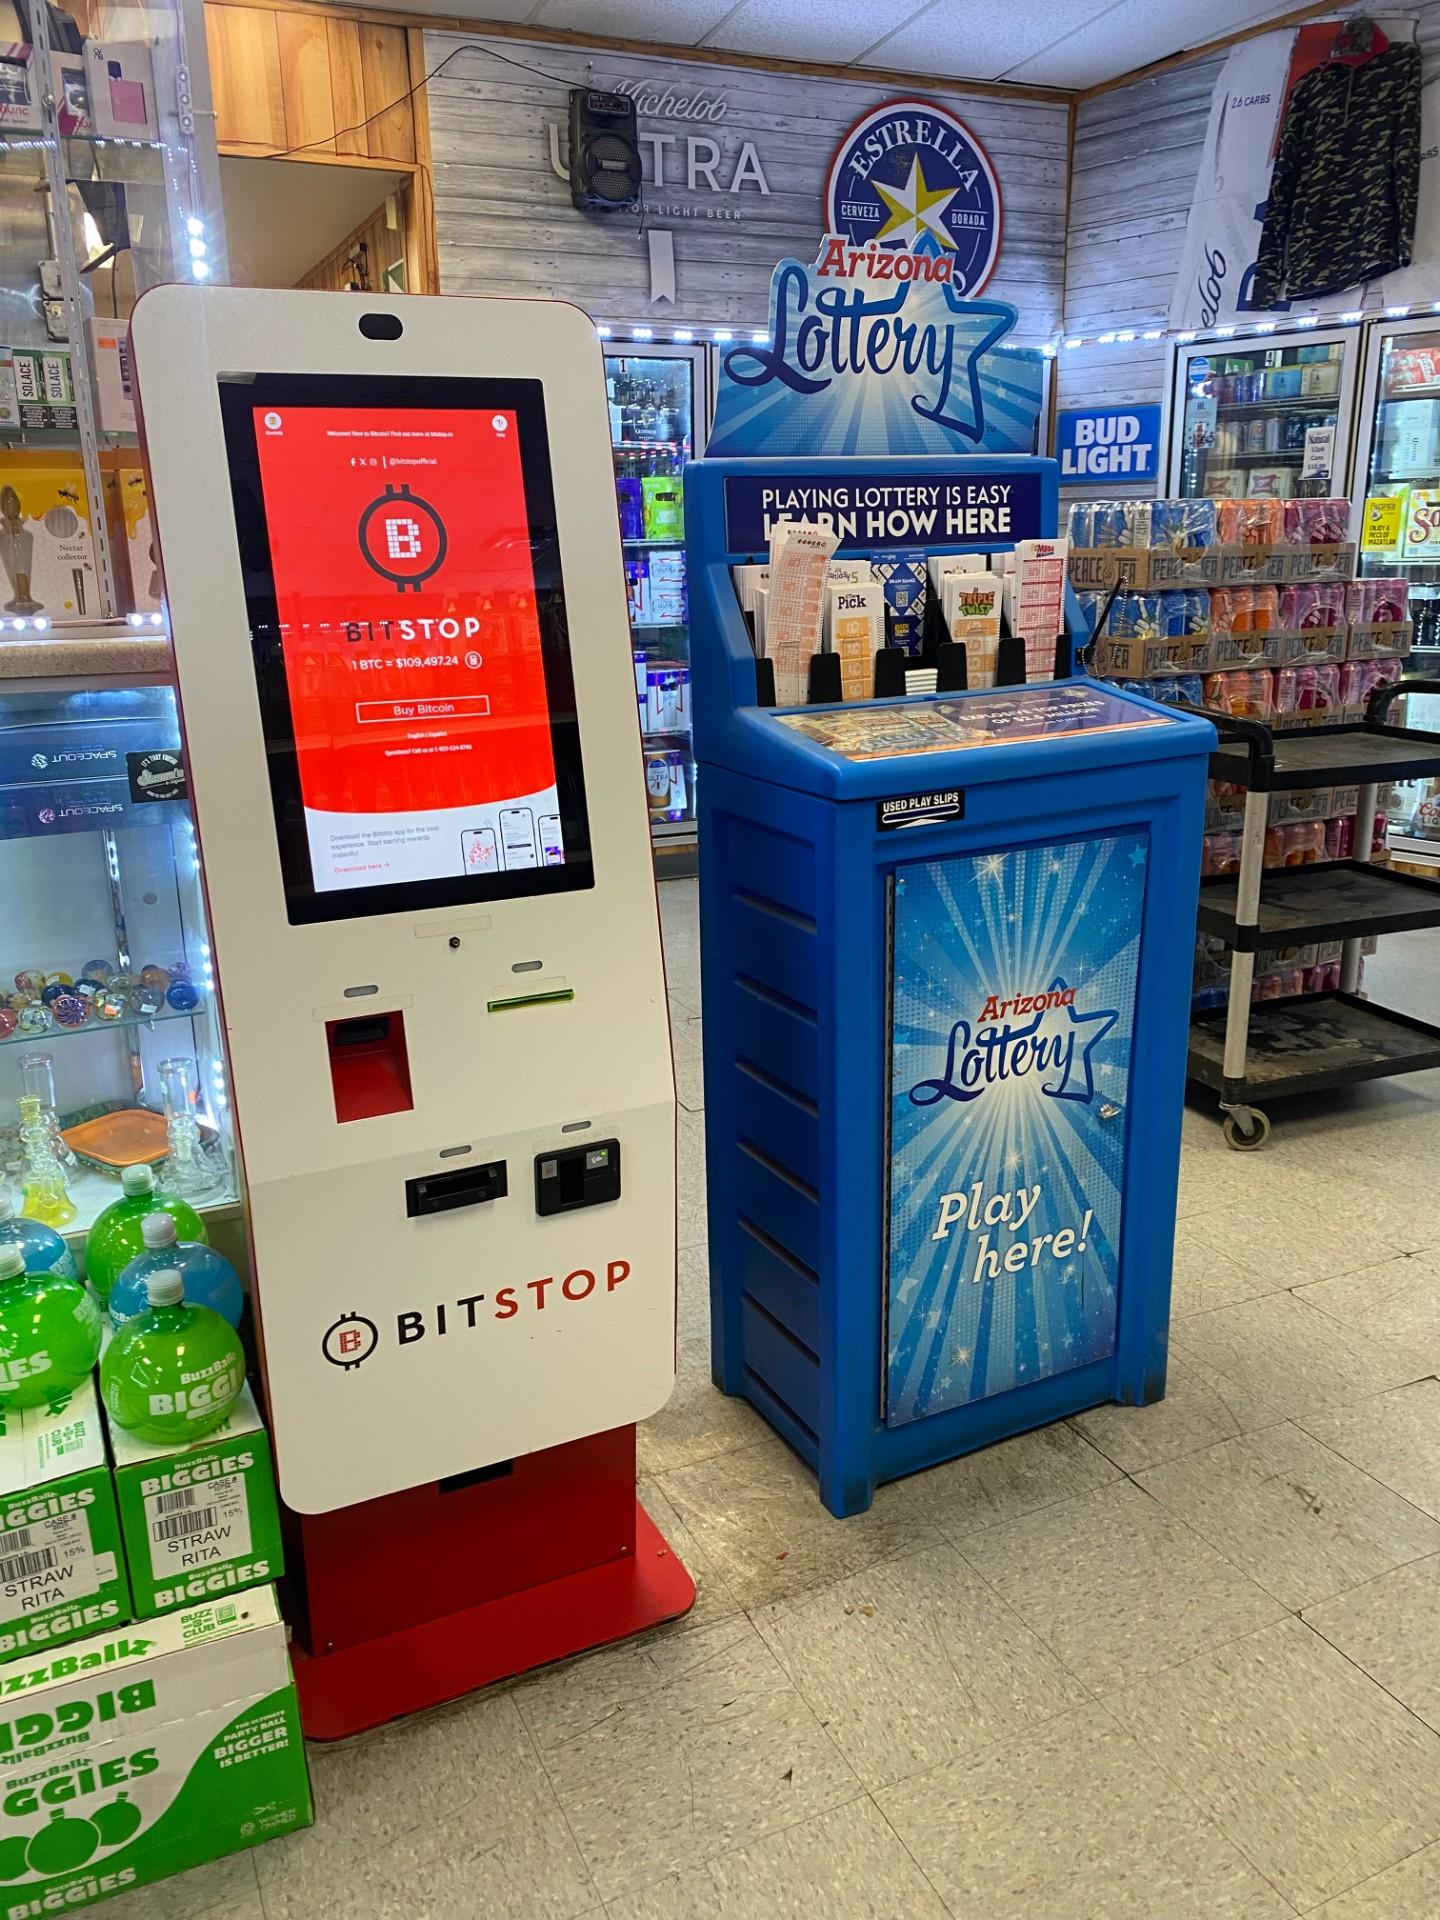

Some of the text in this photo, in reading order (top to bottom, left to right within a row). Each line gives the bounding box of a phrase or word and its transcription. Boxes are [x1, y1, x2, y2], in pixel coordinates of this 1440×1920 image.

[1244, 93, 1271, 106] CARBS
[550, 123, 771, 194] UTRA
[848, 119, 979, 192] ESTRELLA
[658, 206, 698, 217] LIGHT
[707, 209, 741, 220] BEER
[841, 204, 880, 219] CERVEZA
[951, 212, 986, 227] DORADA
[817, 239, 953, 283] Arizona
[724, 264, 980, 440] Lottery
[20, 361, 34, 397] SOLACE
[48, 364, 62, 398] SOLACE
[1075, 416, 1140, 446] BUD
[1062, 444, 1152, 475] LIGHT
[762, 485, 1011, 509] PLAYING LOTTERY IS EASY
[866, 507, 1011, 537] HOW HERE
[57, 553, 88, 561] collector
[838, 593, 867, 610] Pick
[959, 591, 996, 604] TRIPLE
[959, 604, 994, 617] TWIST
[346, 617, 480, 642] BITSTOP
[352, 660, 357, 670] 1
[360, 658, 383, 670] BTC
[395, 655, 459, 669] $109,497.24
[393, 702, 455, 717] Buy Bitcoin
[51, 750, 117, 763] SPACEOUT
[883, 791, 959, 812] USED PLAY SLIPS
[977, 987, 1077, 1023] Arizona
[909, 1012, 1094, 1106] Lottery
[931, 1181, 1041, 1240] Play
[973, 1210, 1093, 1284] here!
[396, 1259, 631, 1345] BITSTOP
[149, 1368, 238, 1416] BIGGI
[141, 1452, 254, 1496] BIGGIES
[0, 1488, 95, 1531] GGIES
[44, 1515, 69, 1529] CASE
[224, 1507, 243, 1518] 15%
[64, 1546, 86, 1558] 15%
[168, 1525, 232, 1553] STRAW
[182, 1546, 222, 1567] RITA
[5, 1565, 73, 1597] STRAW
[154, 1560, 270, 1608] BIGGIES
[22, 1587, 64, 1611] RITA
[0, 1600, 120, 1652] BIGGIES
[181, 1608, 213, 1624] BUZZ
[183, 1623, 215, 1639] CLUB
[0, 1639, 157, 1697] zzBallz
[0, 1679, 156, 1754] BIGGI
[224, 1716, 287, 1742] PARTY BALL
[235, 1710, 285, 1730] THE ULTIMATE
[214, 1726, 288, 1760] BIGGER
[220, 1739, 289, 1768] IS BETTER!
[3, 1747, 159, 1817] GGIES
[8, 1867, 137, 1920] BIGGIES
